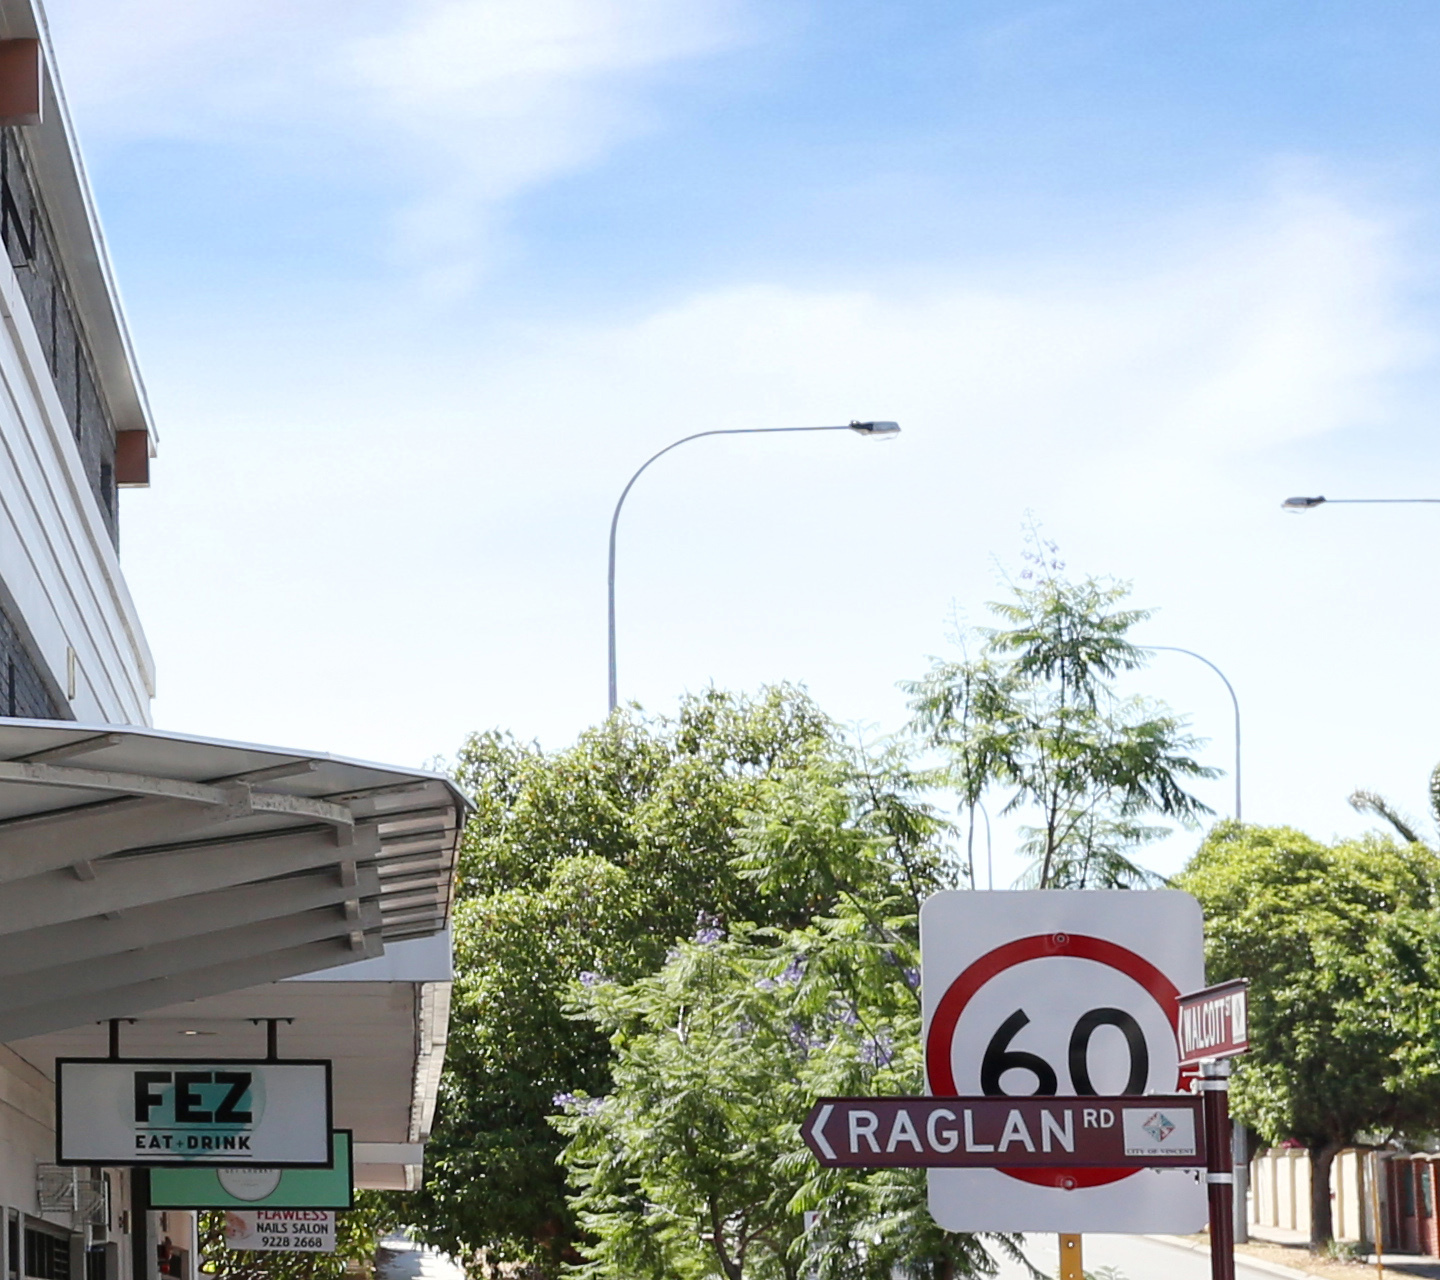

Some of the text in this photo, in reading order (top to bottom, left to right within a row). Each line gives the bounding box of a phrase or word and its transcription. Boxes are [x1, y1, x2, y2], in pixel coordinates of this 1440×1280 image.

[1183, 998, 1226, 1053] WALCOTT
[980, 1006, 1149, 1097] 60
[134, 1071, 253, 1123] FEZ
[848, 1107, 1115, 1154] RAGLAN RD
[256, 1210, 329, 1221] FLAWLESS
[256, 1222, 329, 1235] NAILS SALON
[262, 1236, 323, 1248] 9228 2668
